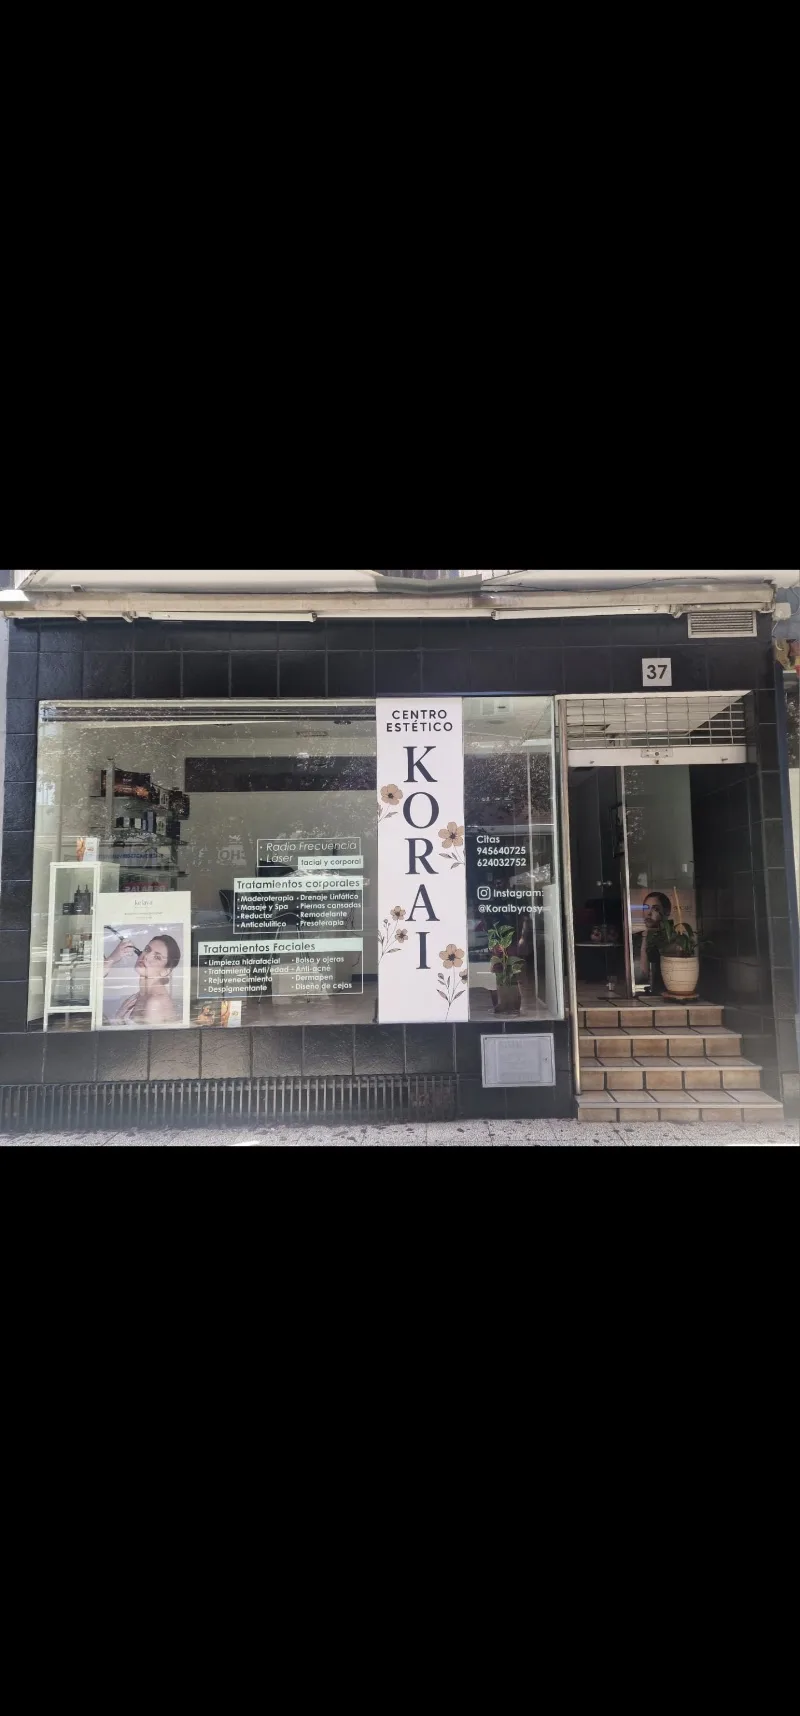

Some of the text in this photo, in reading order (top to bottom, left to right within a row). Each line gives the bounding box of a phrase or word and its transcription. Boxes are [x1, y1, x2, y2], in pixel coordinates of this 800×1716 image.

[646, 664, 668, 680] 37
[391, 709, 448, 720] CENTRO
[386, 720, 453, 732] ESTÉTICO
[476, 835, 500, 844] Citas
[266, 840, 357, 851] Radio Frecuencia
[476, 846, 526, 855] 945640725
[266, 853, 293, 863] Láser
[402, 745, 440, 970] KORAI
[330, 858, 361, 867] corporal
[477, 858, 527, 867] 624032752
[237, 878, 360, 890] Tratamientos corporales
[300, 893, 359, 902] Drenaje Linfático
[493, 889, 544, 899] Instagram:
[240, 895, 294, 903] Maderoterapia
[240, 904, 267, 912] Masaje
[274, 903, 289, 912] Spa
[478, 904, 543, 915] @Koraibyrosy
[300, 919, 345, 928] Presoterapia
[203, 942, 316, 954] Tratamientos Faciales
[208, 958, 240, 967] Limpieza
[322, 956, 345, 964] ojeras
[208, 975, 273, 984] Rejuvenecimiento
[208, 985, 268, 993] Despigmentante
[332, 981, 353, 990] cejas
